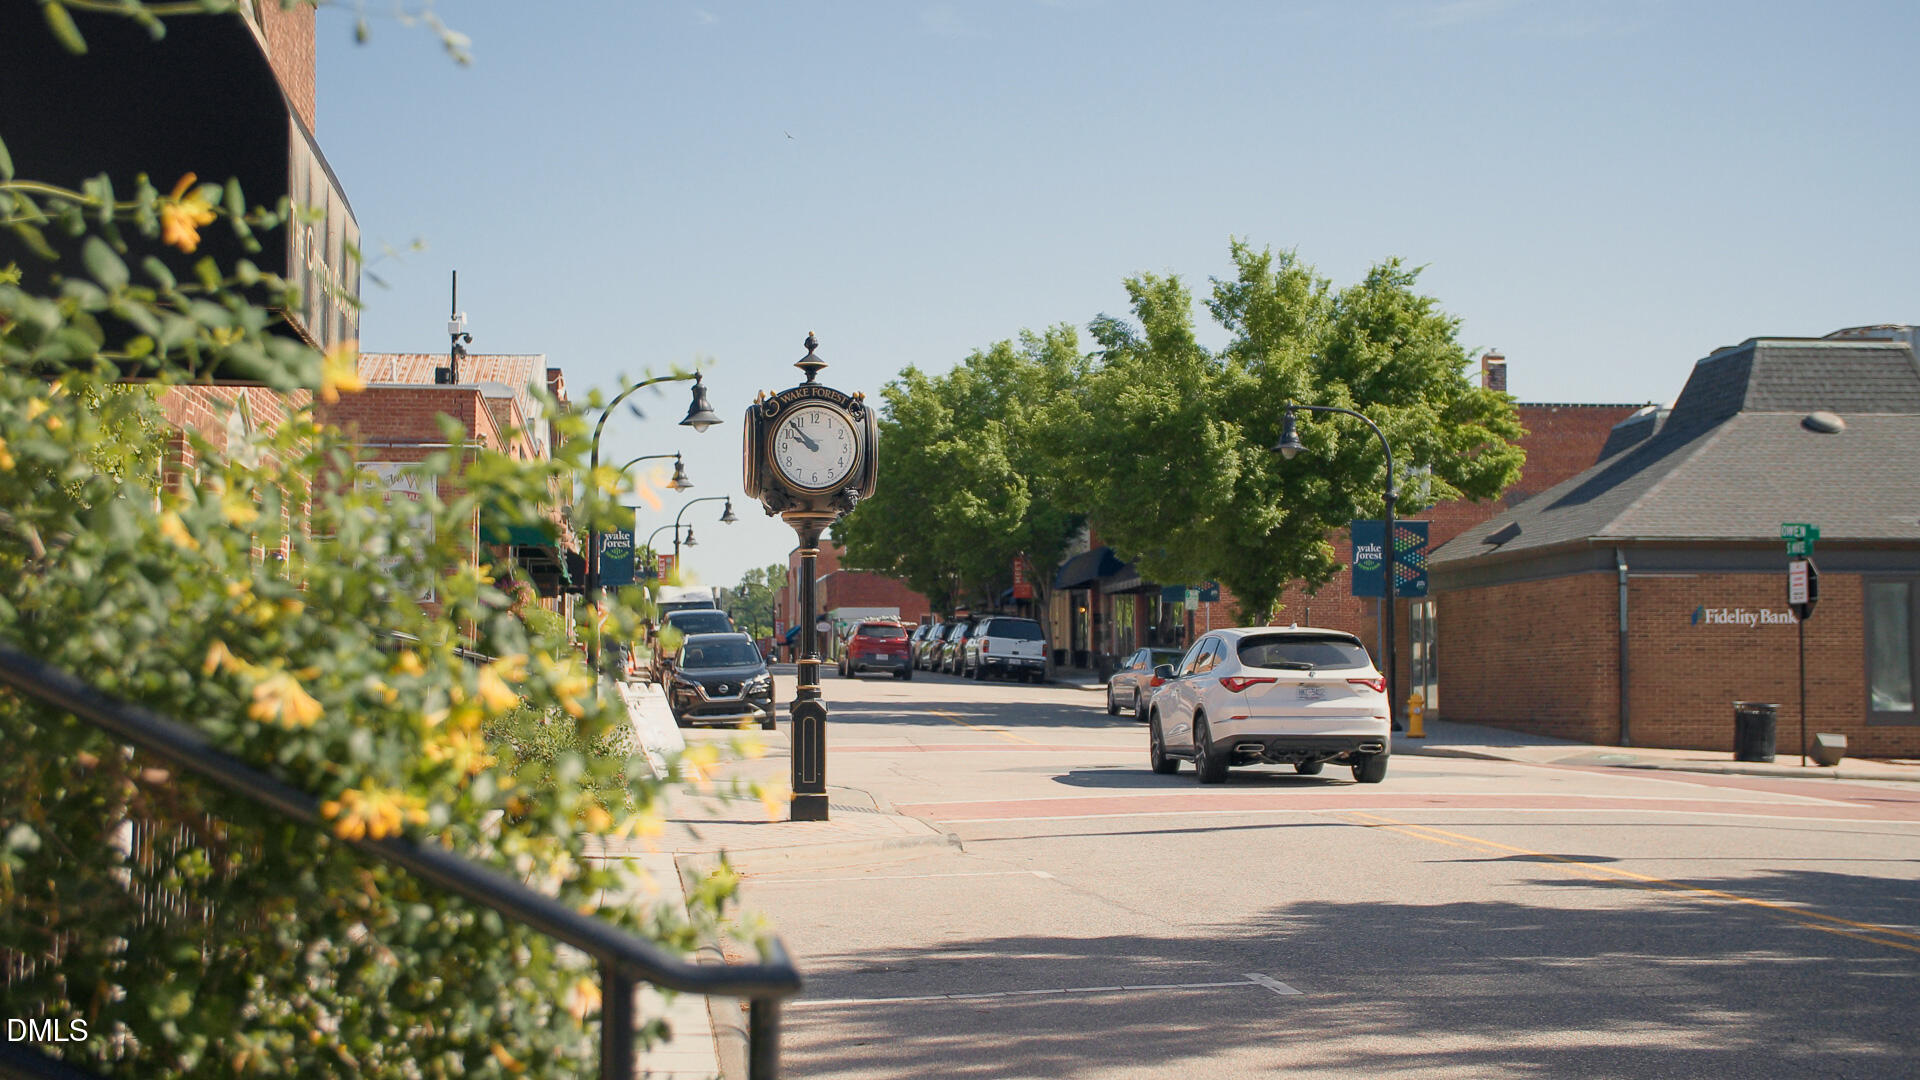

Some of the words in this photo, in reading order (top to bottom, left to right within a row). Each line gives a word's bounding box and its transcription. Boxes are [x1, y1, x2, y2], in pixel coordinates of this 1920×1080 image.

[781, 389, 809, 403] WAKE
[812, 388, 848, 404] FOREST
[797, 417, 804, 428] 11
[810, 413, 820, 424] 12
[828, 418, 832, 428] 1
[785, 429, 794, 439] 10
[838, 429, 844, 440] 2
[782, 443, 788, 453] 9
[842, 444, 848, 454] 3
[786, 456, 792, 467] 8
[837, 457, 843, 468] 4
[796, 469, 802, 478] 7
[811, 472, 818, 482] 6
[827, 469, 834, 479] 5
[604, 531, 630, 540] wake
[601, 539, 631, 552] forest
[1357, 543, 1382, 552] wake
[1353, 551, 1383, 564] forest
[1705, 608, 1759, 628] Fidelity
[1760, 608, 1799, 624] Bank
